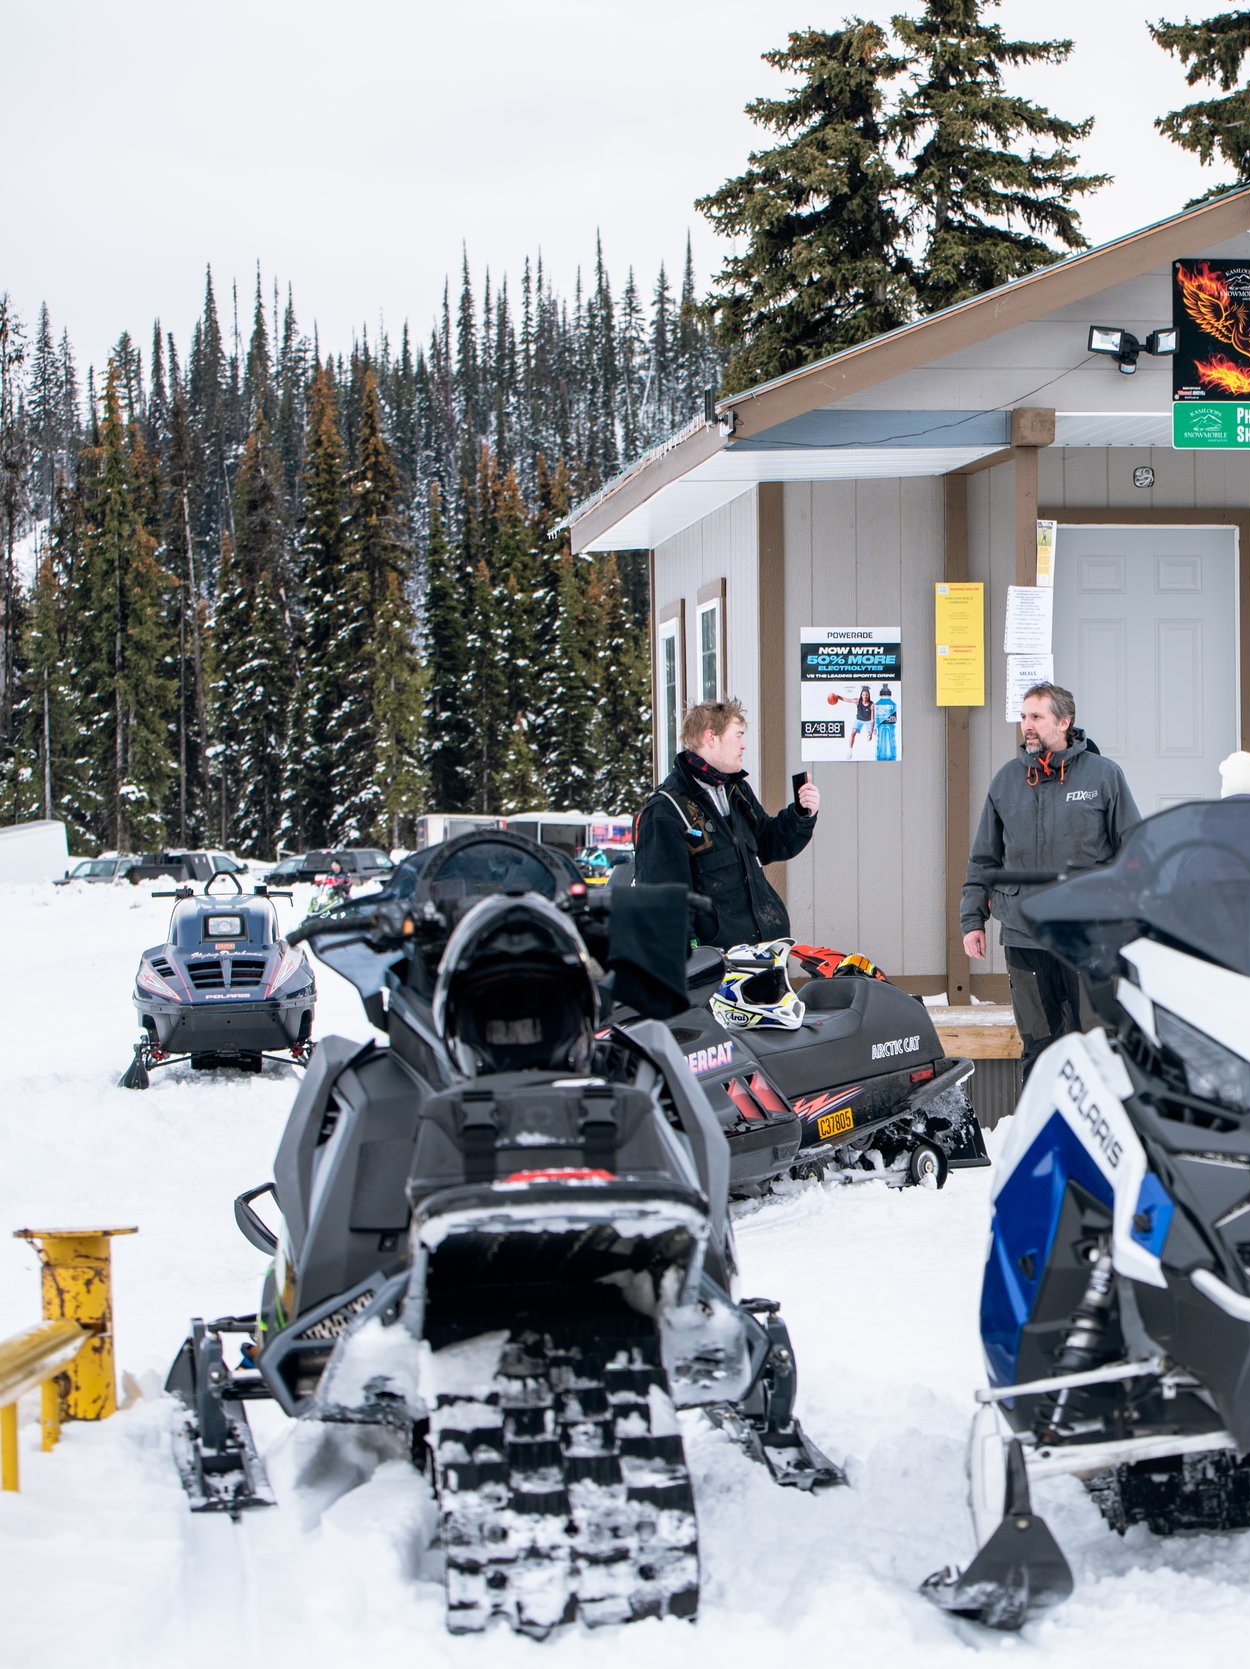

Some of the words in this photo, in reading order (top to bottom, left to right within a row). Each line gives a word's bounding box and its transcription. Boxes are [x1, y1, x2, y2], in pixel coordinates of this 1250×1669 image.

[1189, 408, 1222, 417] KAMLOOPS
[1184, 431, 1228, 439] SNOWMOBILE
[827, 631, 873, 639] POWERADE
[818, 646, 850, 655] NOW
[851, 646, 884, 655] WITH
[806, 655, 846, 665] 50%
[847, 655, 897, 665] MORE
[1066, 790, 1087, 802] FOX
[871, 1039, 902, 1060] ARCTIC
[903, 1035, 920, 1053] CAT
[684, 1040, 734, 1072] ERCAT
[1058, 1059, 1125, 1170] POLARIS
[819, 1112, 852, 1138] C37805
